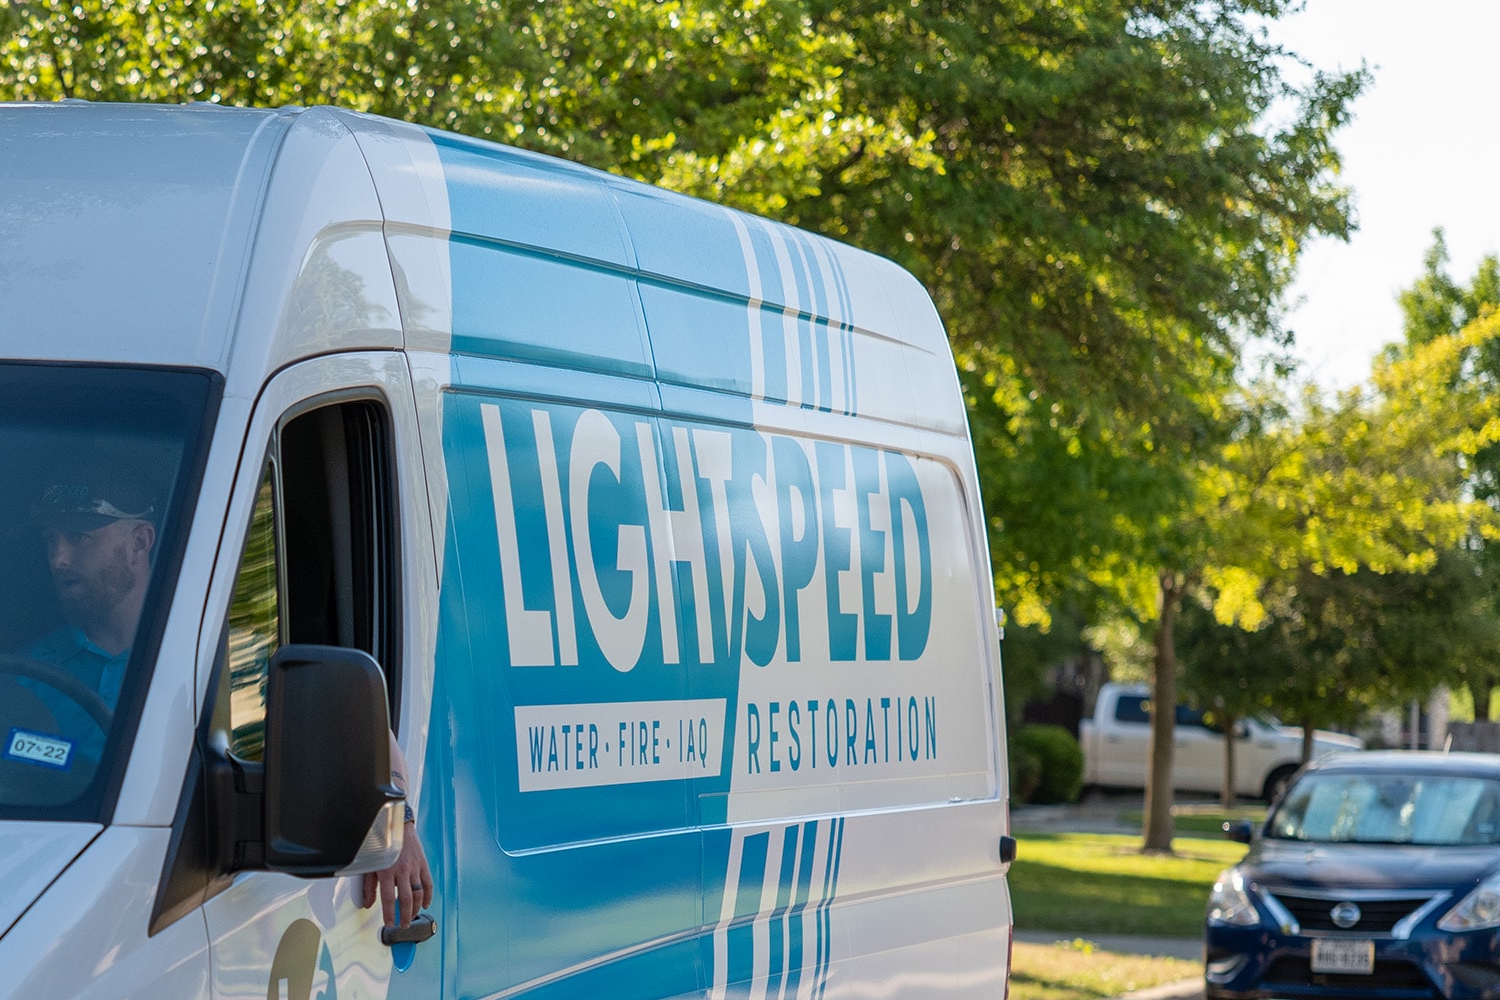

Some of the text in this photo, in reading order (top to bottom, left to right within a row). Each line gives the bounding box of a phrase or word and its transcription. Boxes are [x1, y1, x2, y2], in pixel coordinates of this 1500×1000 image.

[528, 717, 708, 773] WATER FIRE IAQ
[747, 695, 937, 774] RESTORATION
